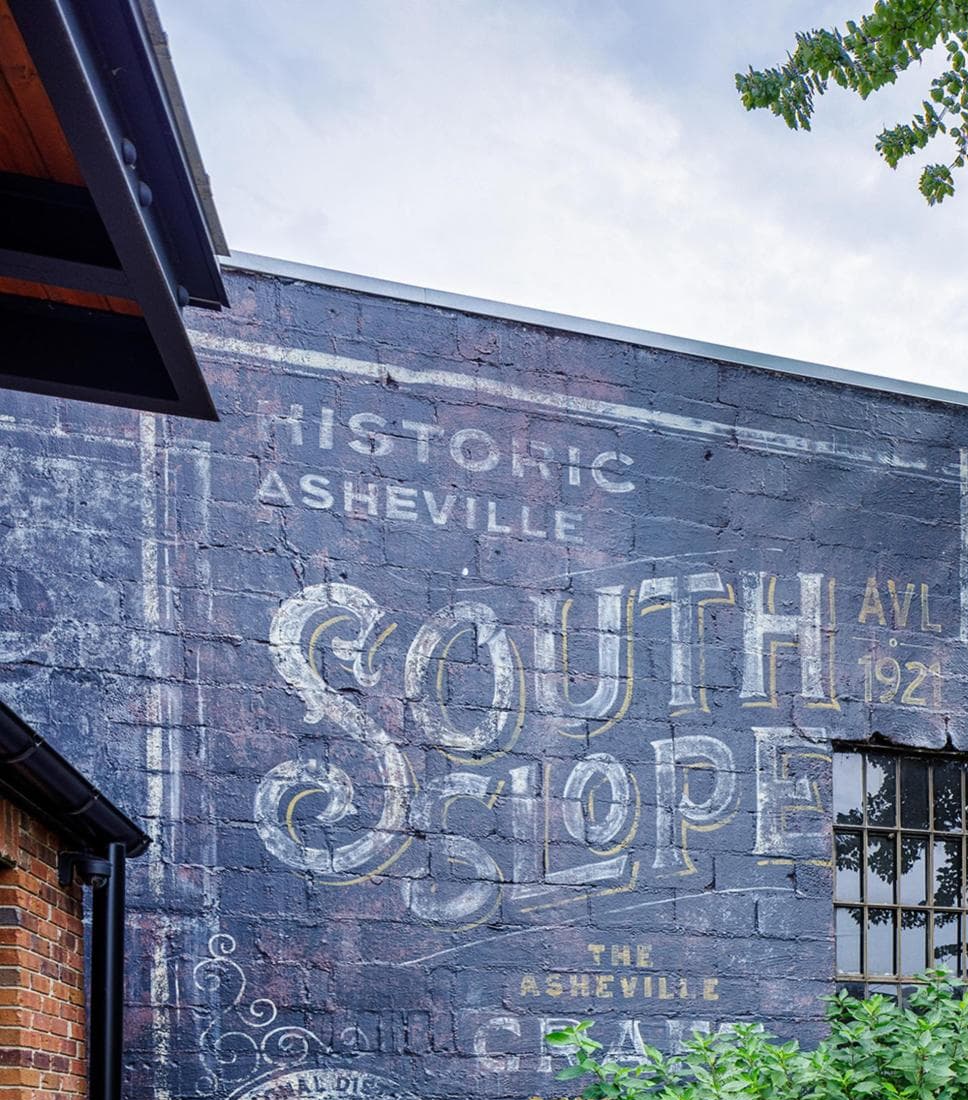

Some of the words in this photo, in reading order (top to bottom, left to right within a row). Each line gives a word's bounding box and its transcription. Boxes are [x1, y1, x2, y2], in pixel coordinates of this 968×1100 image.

[256, 399, 636, 494] HISTORIC
[256, 469, 585, 544] ASHEVILLE
[858, 575, 943, 633] AVL
[857, 654, 943, 710] 1921
[254, 571, 841, 873] SOUTH
[402, 726, 833, 926] SLOPE
[519, 973, 721, 1000] ASHEVILLE
[588, 943, 654, 968] THE
